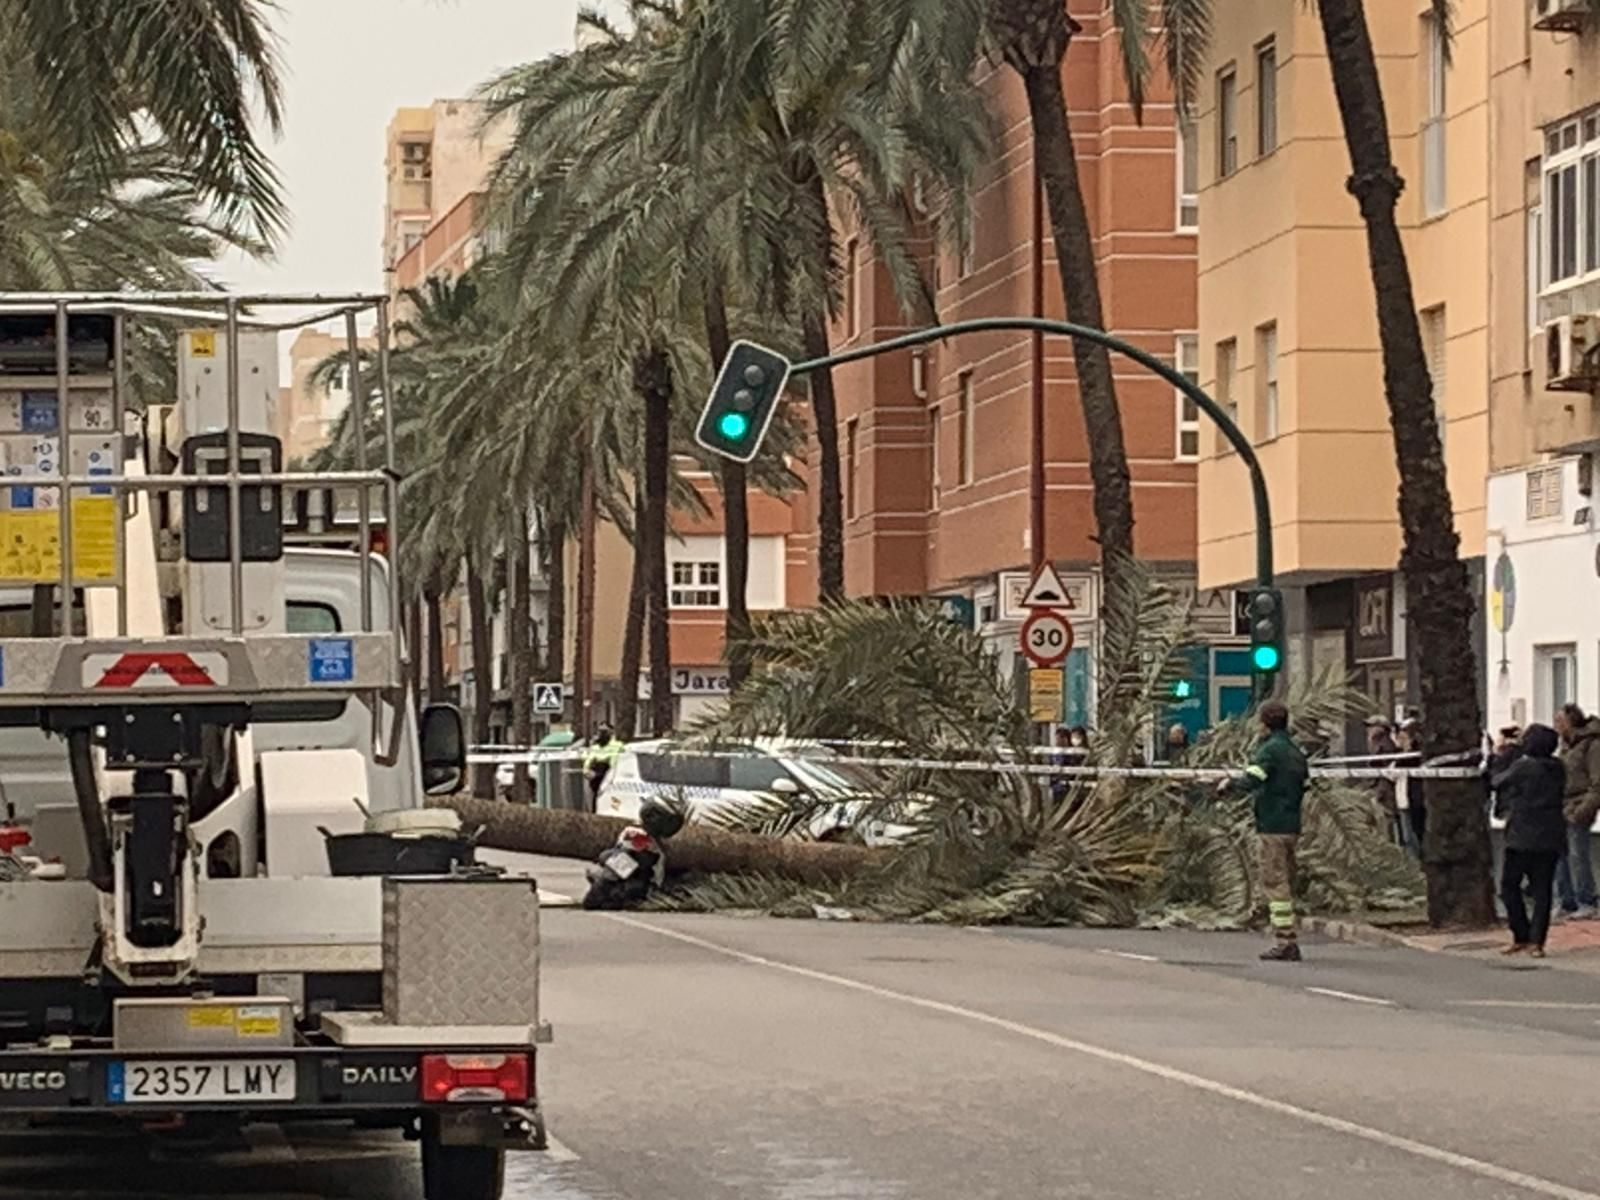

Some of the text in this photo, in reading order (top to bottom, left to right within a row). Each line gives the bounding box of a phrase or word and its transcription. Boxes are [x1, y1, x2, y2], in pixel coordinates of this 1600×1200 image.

[1032, 628, 1063, 647] 30
[132, 1066, 212, 1096] 2357
[224, 1064, 283, 1095] LMY
[342, 1066, 418, 1084] DAILY
